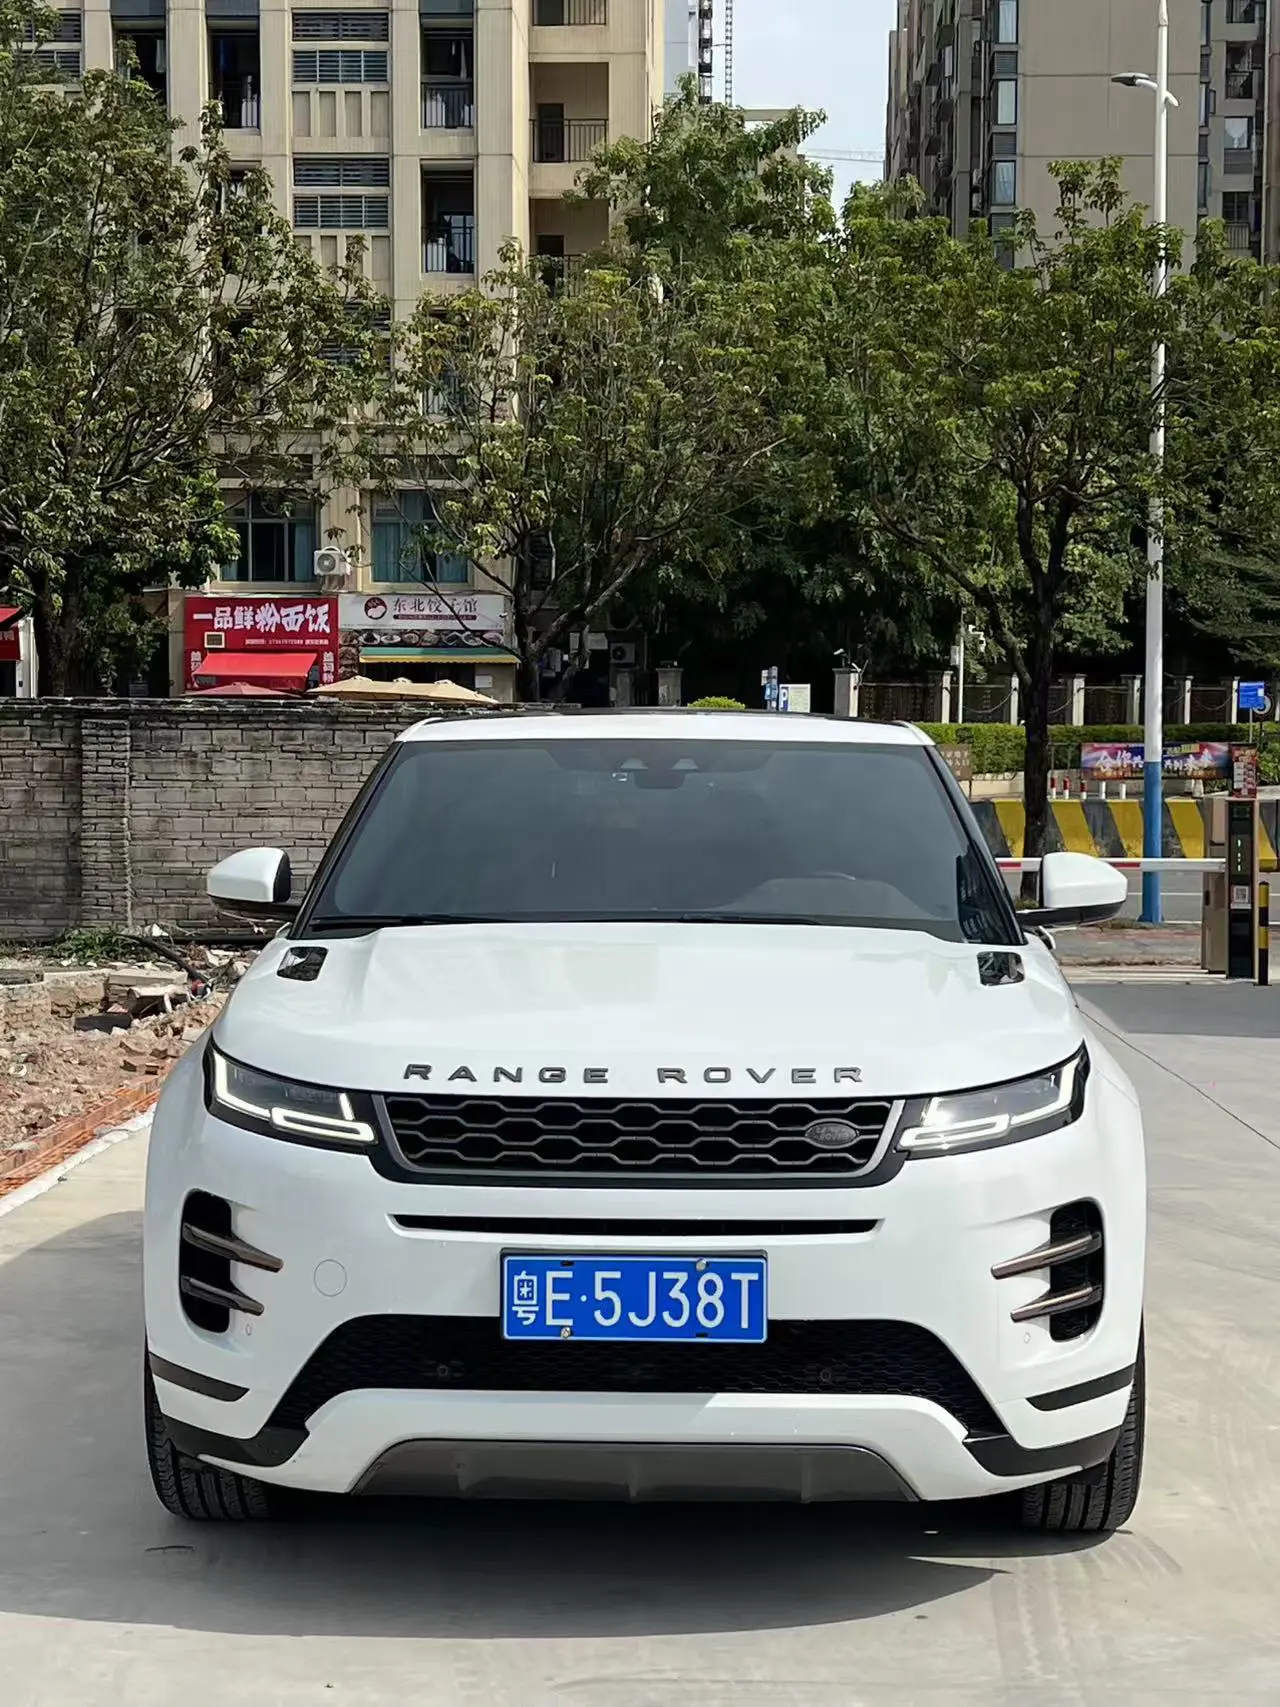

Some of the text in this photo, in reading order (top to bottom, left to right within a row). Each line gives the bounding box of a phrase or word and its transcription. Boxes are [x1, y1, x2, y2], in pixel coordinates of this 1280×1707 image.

[193, 602, 331, 634] 一品鲜粉面饭
[403, 1063, 863, 1085] RANGE ROVER
[511, 1270, 759, 1329] 粤E·5J38T
